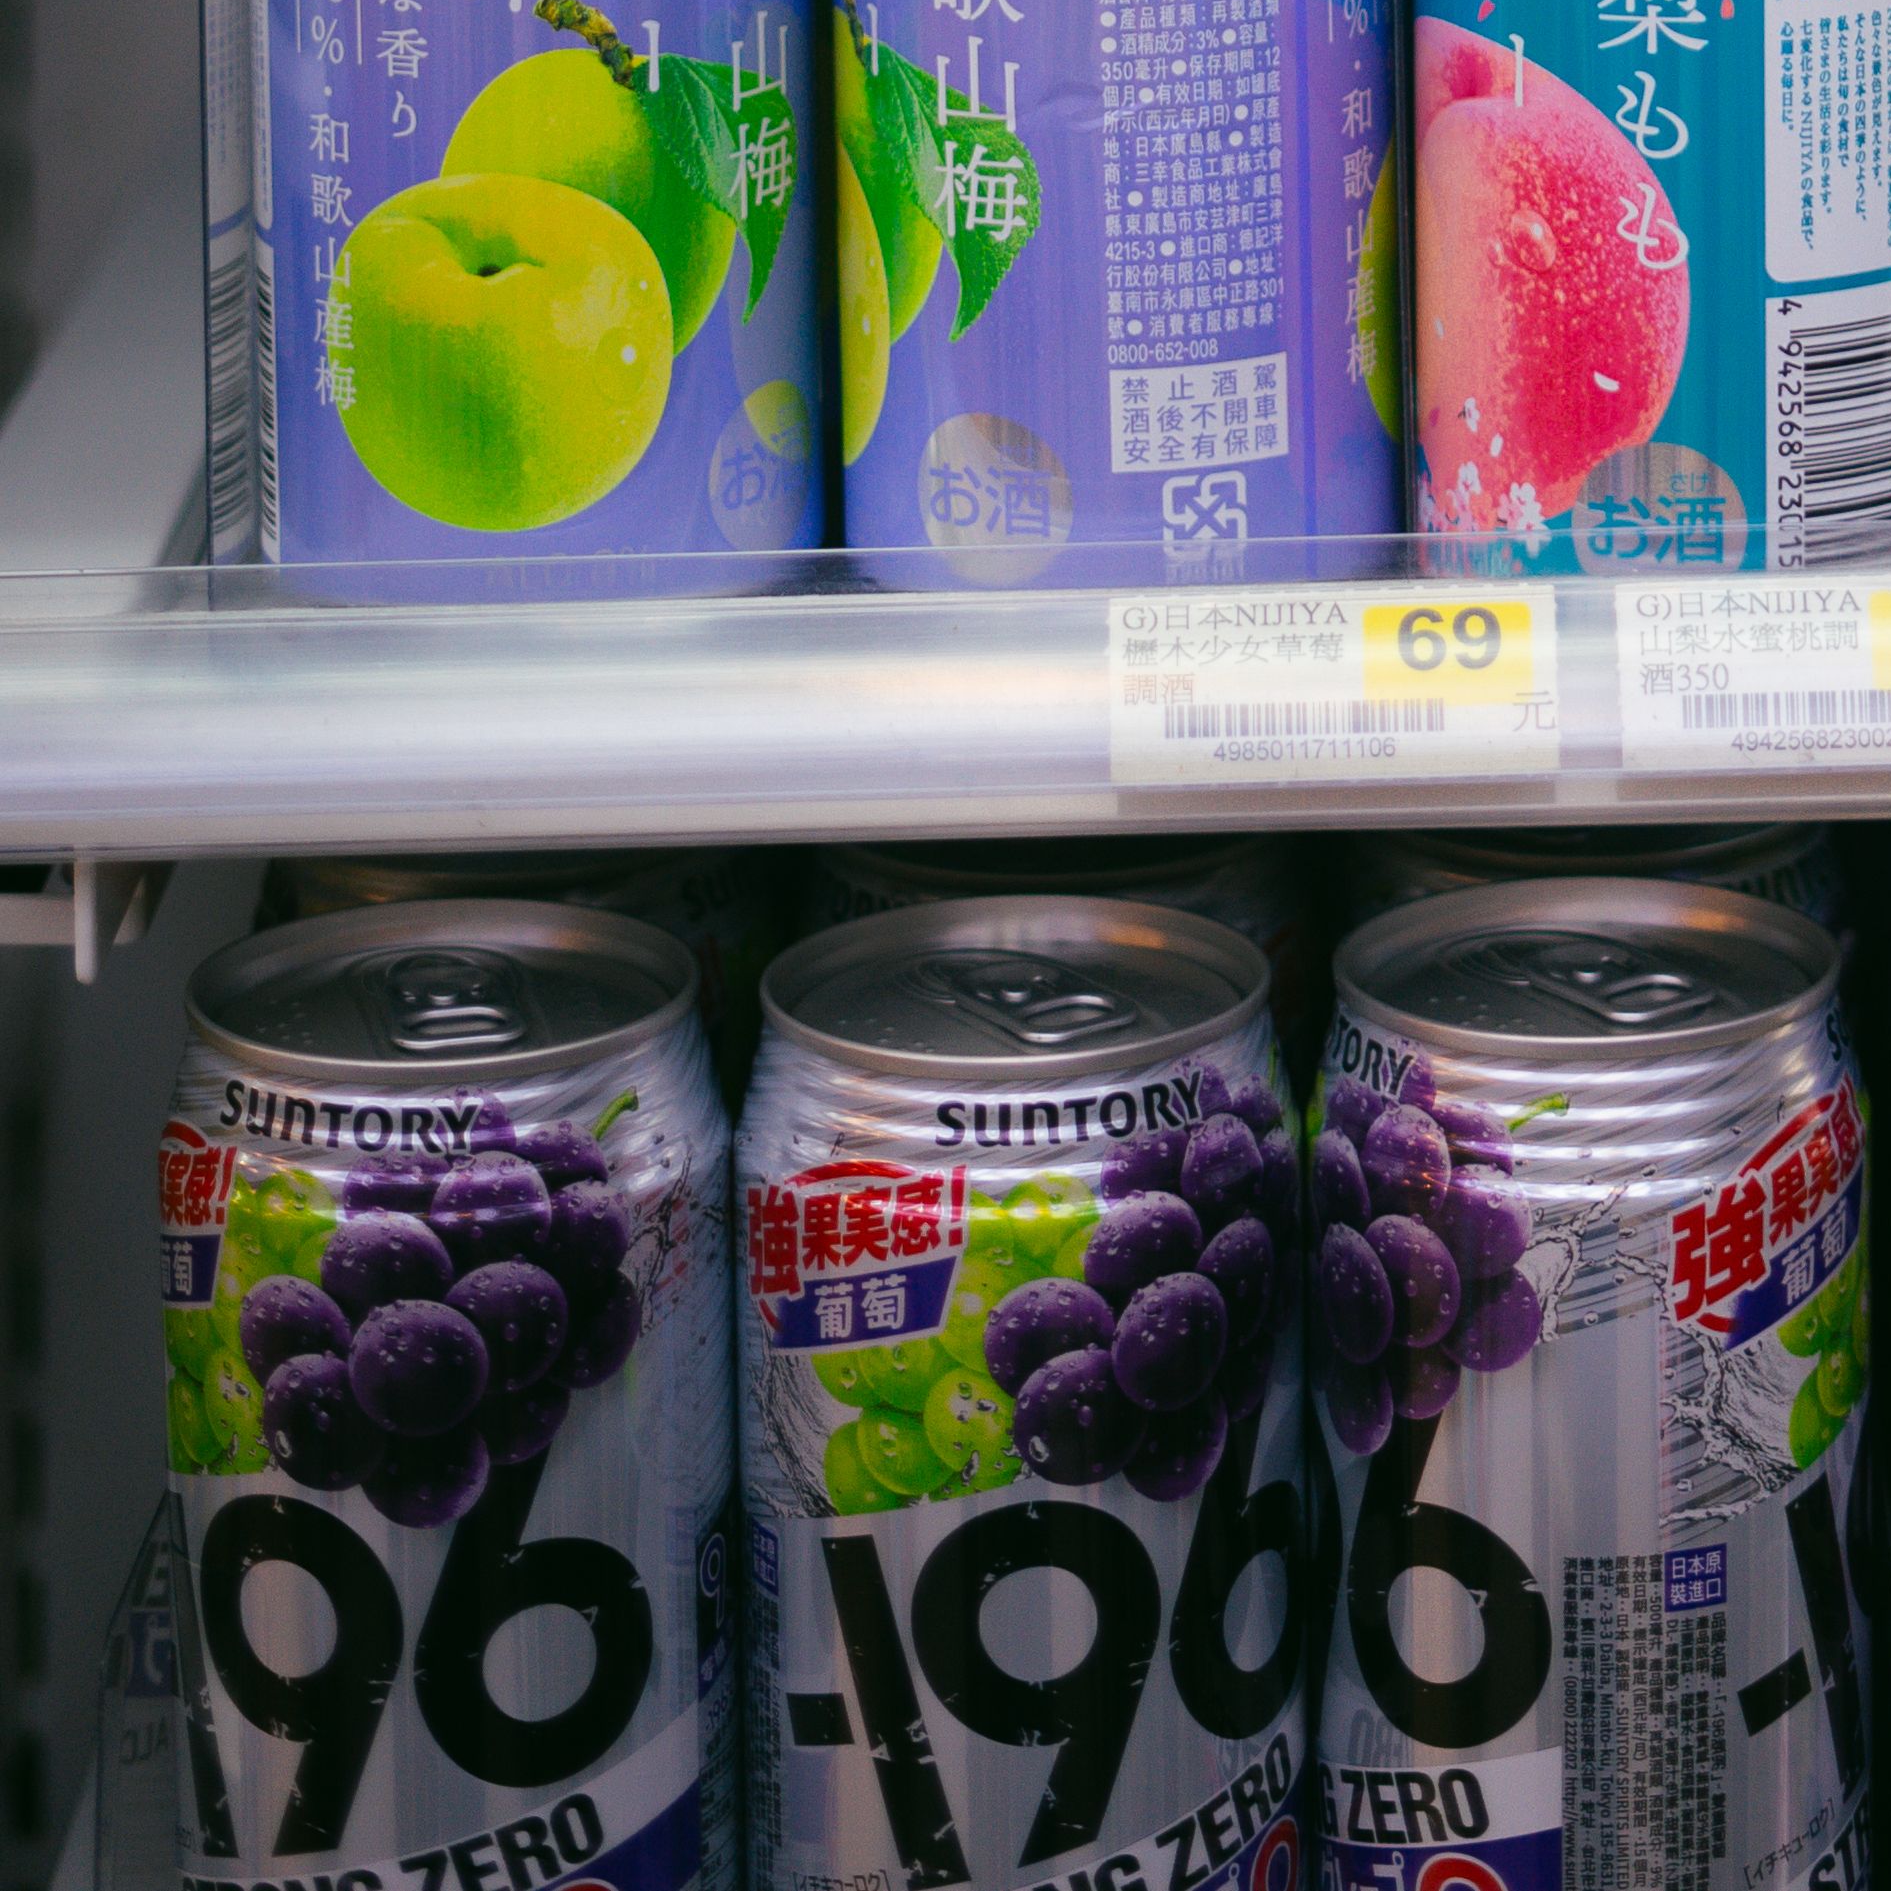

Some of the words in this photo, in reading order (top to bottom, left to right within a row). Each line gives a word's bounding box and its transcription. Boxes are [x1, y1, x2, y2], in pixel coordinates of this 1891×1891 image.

[1107, 338, 1220, 365] 0800-652-008
[1121, 363, 1278, 405] 禁止酒駕
[1122, 393, 1279, 435] 酒後不開車
[1123, 423, 1279, 465] 安全有保障
[926, 449, 1054, 541] お酒
[1586, 489, 1727, 565] お酒
[1121, 599, 1350, 632] G)日本NIJIYA
[1635, 587, 1864, 620] G)日本NIJIYA
[1396, 605, 1503, 671] 69
[1639, 620, 1861, 656] 山梨水蜜桃調
[1121, 672, 1197, 706] 調酒
[1639, 660, 1731, 695] 酒350
[1512, 690, 1557, 732] 元
[1212, 736, 1398, 763] 4985011711106
[221, 1076, 482, 1157] SUNTORY
[934, 1070, 1204, 1150] SUNTORY
[1780, 1212, 1852, 1304] 葡萄
[813, 1273, 909, 1342] 葡萄
[1615, 1707, 1630, 1776] SUNTORY
[1341, 1766, 1490, 1844] ZERO
[1615, 1777, 1630, 1827] SPIRITS
[1615, 1828, 1630, 1891] LIMITED
